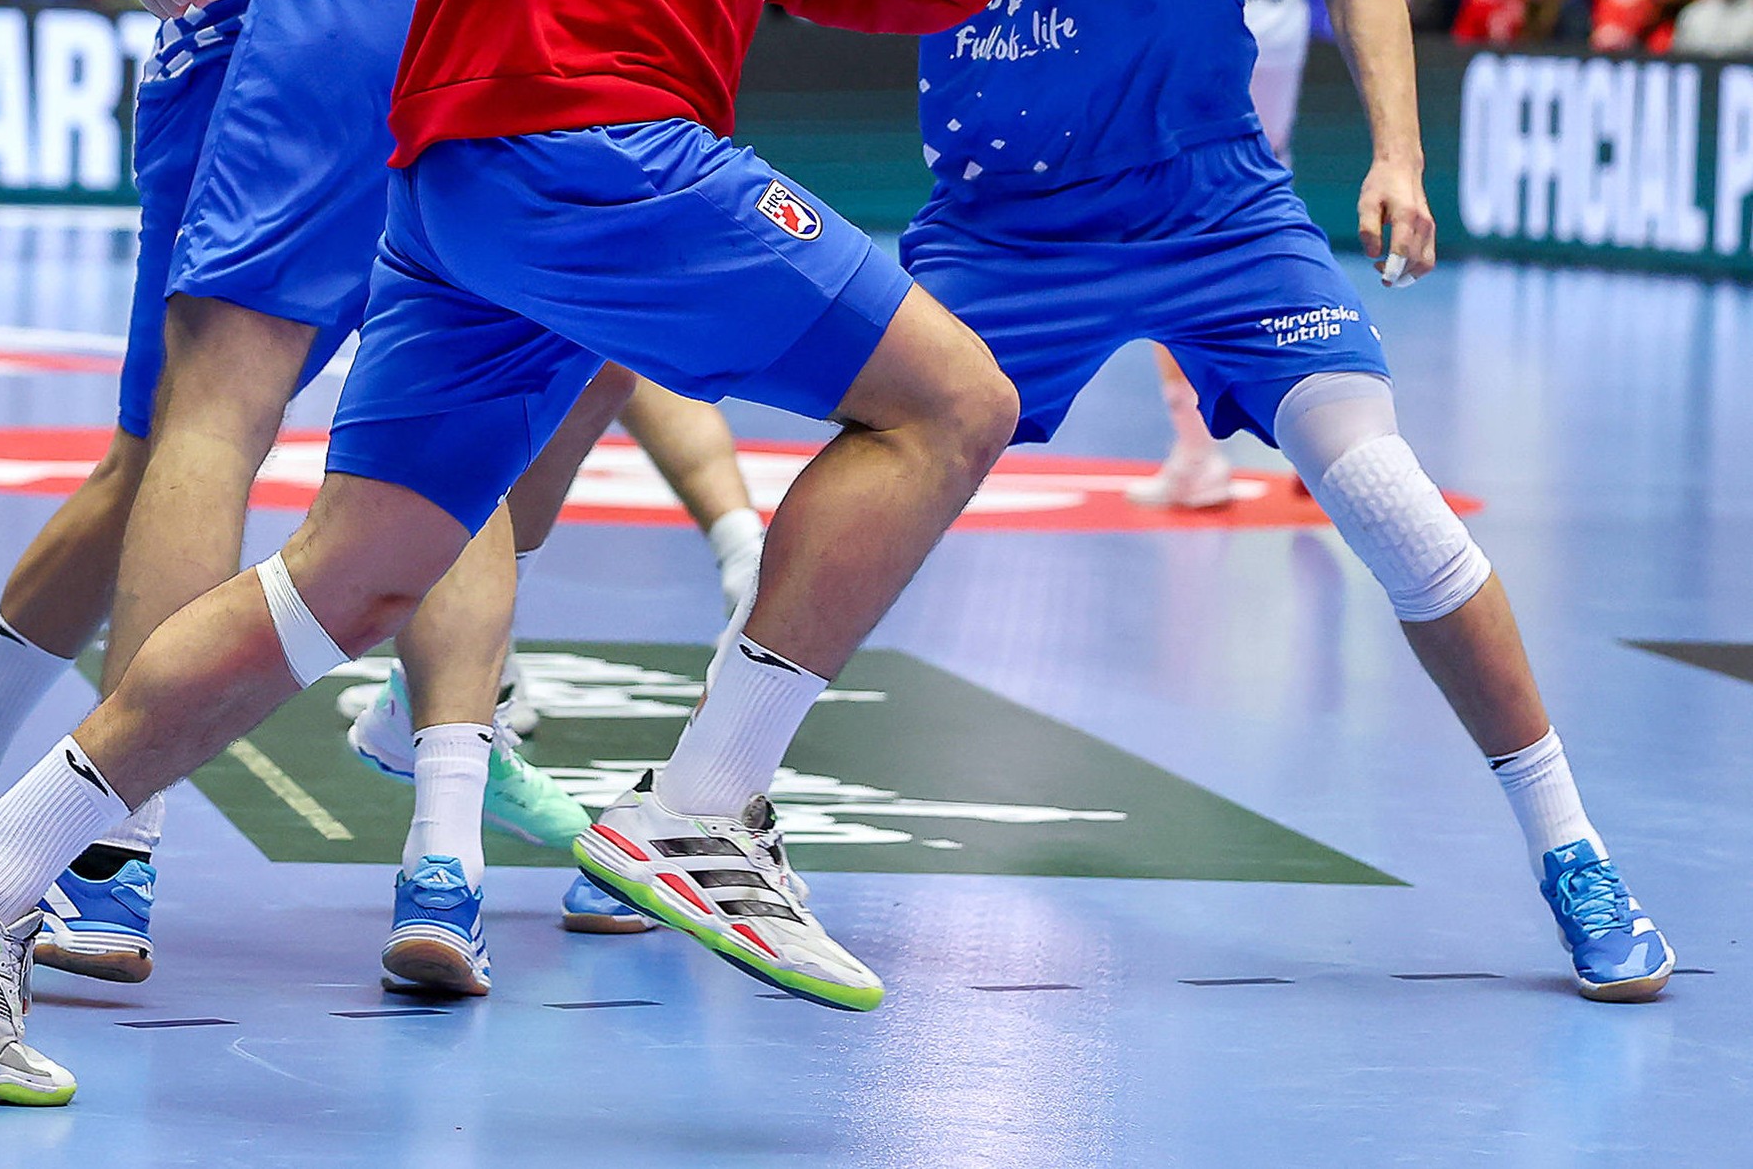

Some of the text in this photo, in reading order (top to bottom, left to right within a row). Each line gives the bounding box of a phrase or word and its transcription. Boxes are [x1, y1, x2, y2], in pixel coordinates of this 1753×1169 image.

[762, 186, 787, 214] HRS
[1273, 305, 1360, 332] Hrvatska
[1276, 322, 1342, 348] Lutrija
